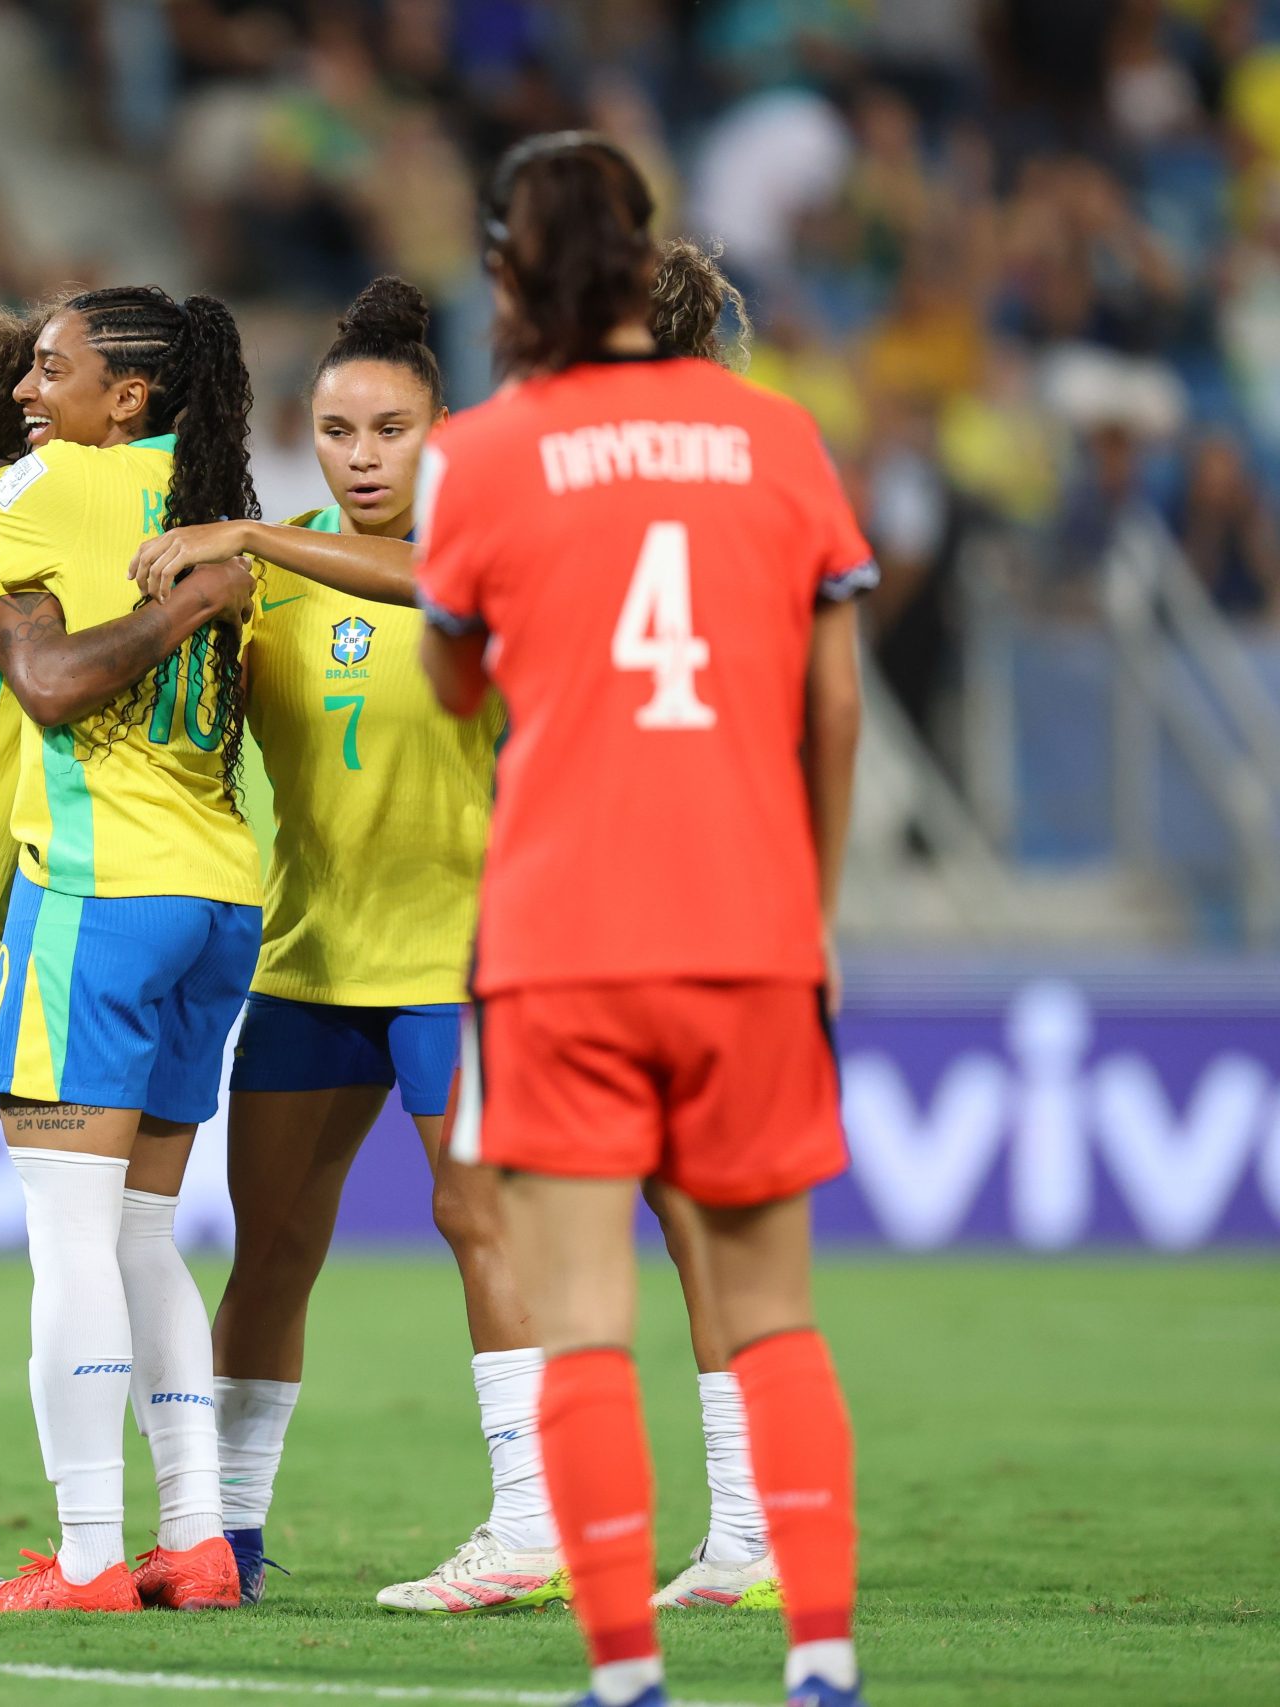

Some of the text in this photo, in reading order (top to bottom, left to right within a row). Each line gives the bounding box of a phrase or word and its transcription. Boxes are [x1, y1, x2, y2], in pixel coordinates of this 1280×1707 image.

[611, 519, 718, 730] 4
[325, 669, 370, 679] BRASIL
[323, 695, 365, 770] 7
[62, 1105, 78, 1116] EU
[81, 1105, 105, 1116] SOU
[835, 972, 1280, 1252] viv
[16, 1118, 86, 1131] EM VENCER
[73, 1363, 133, 1376] BRAS
[151, 1392, 215, 1409] BRASI
